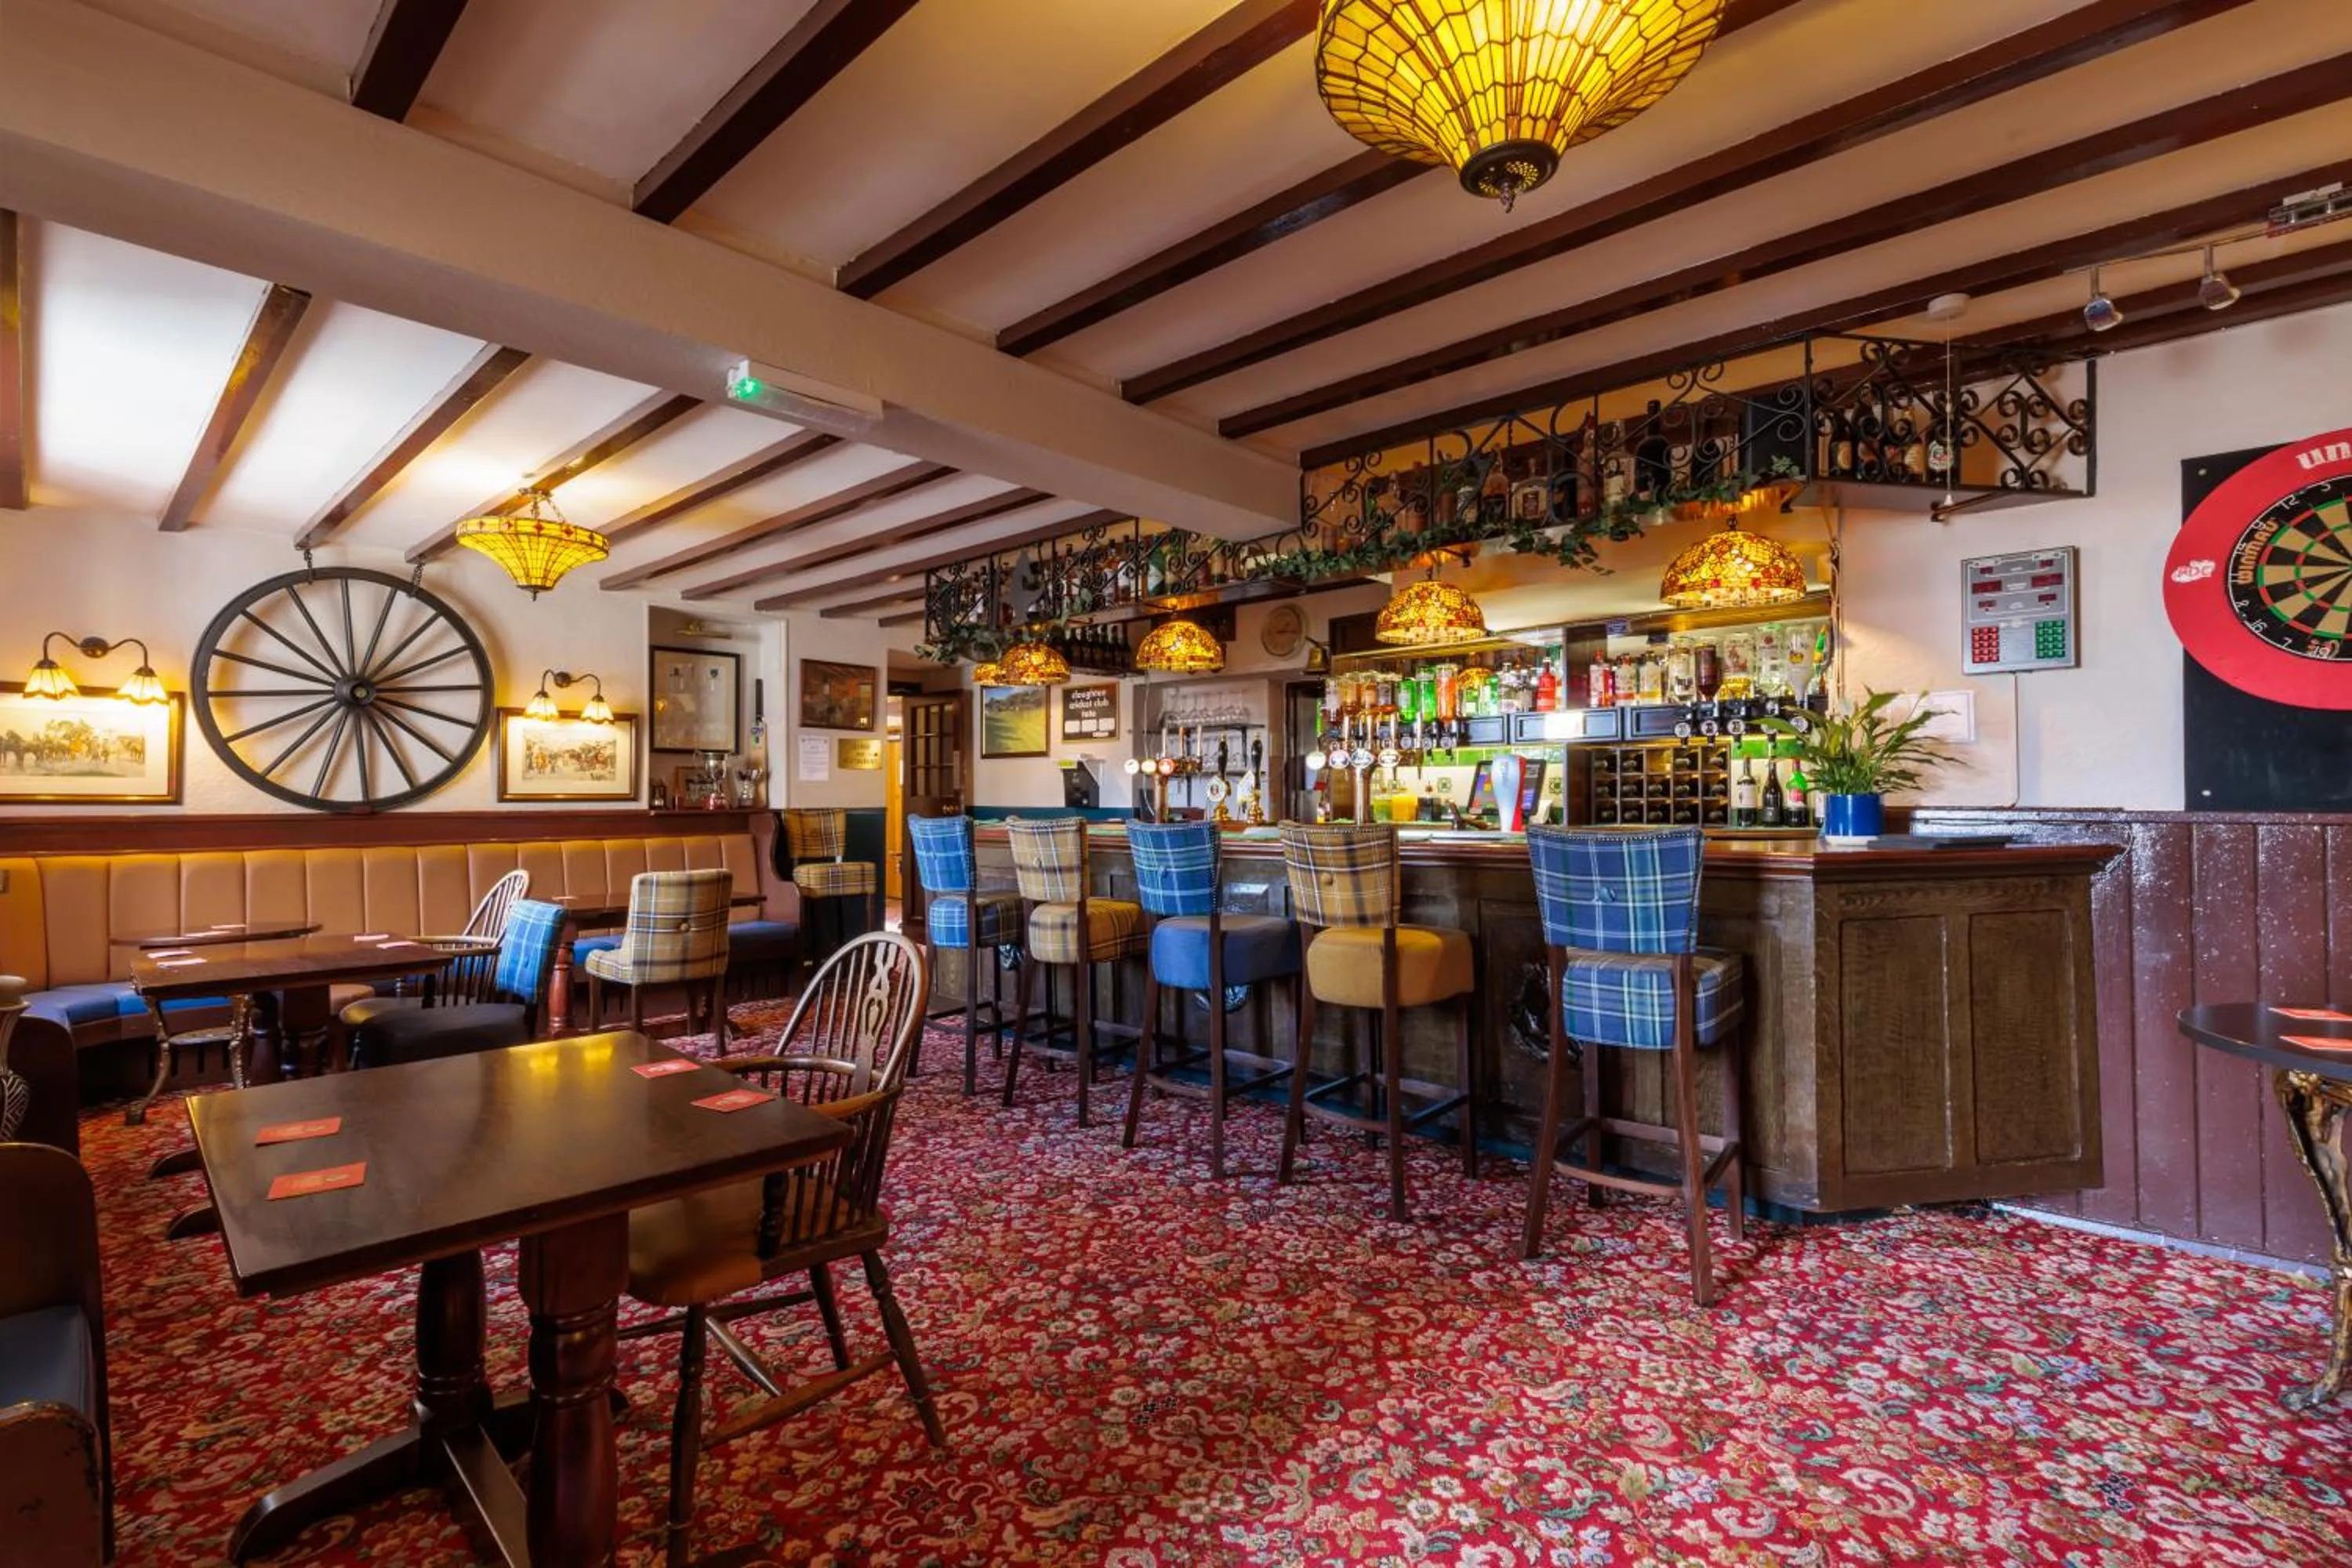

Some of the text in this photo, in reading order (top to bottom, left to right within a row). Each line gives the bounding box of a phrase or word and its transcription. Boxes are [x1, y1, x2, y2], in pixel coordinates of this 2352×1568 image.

[2281, 494, 2300, 510] 12
[2237, 517, 2279, 585] WINMAU
[2252, 619, 2267, 633] 16
[2282, 637, 2293, 648] 7
